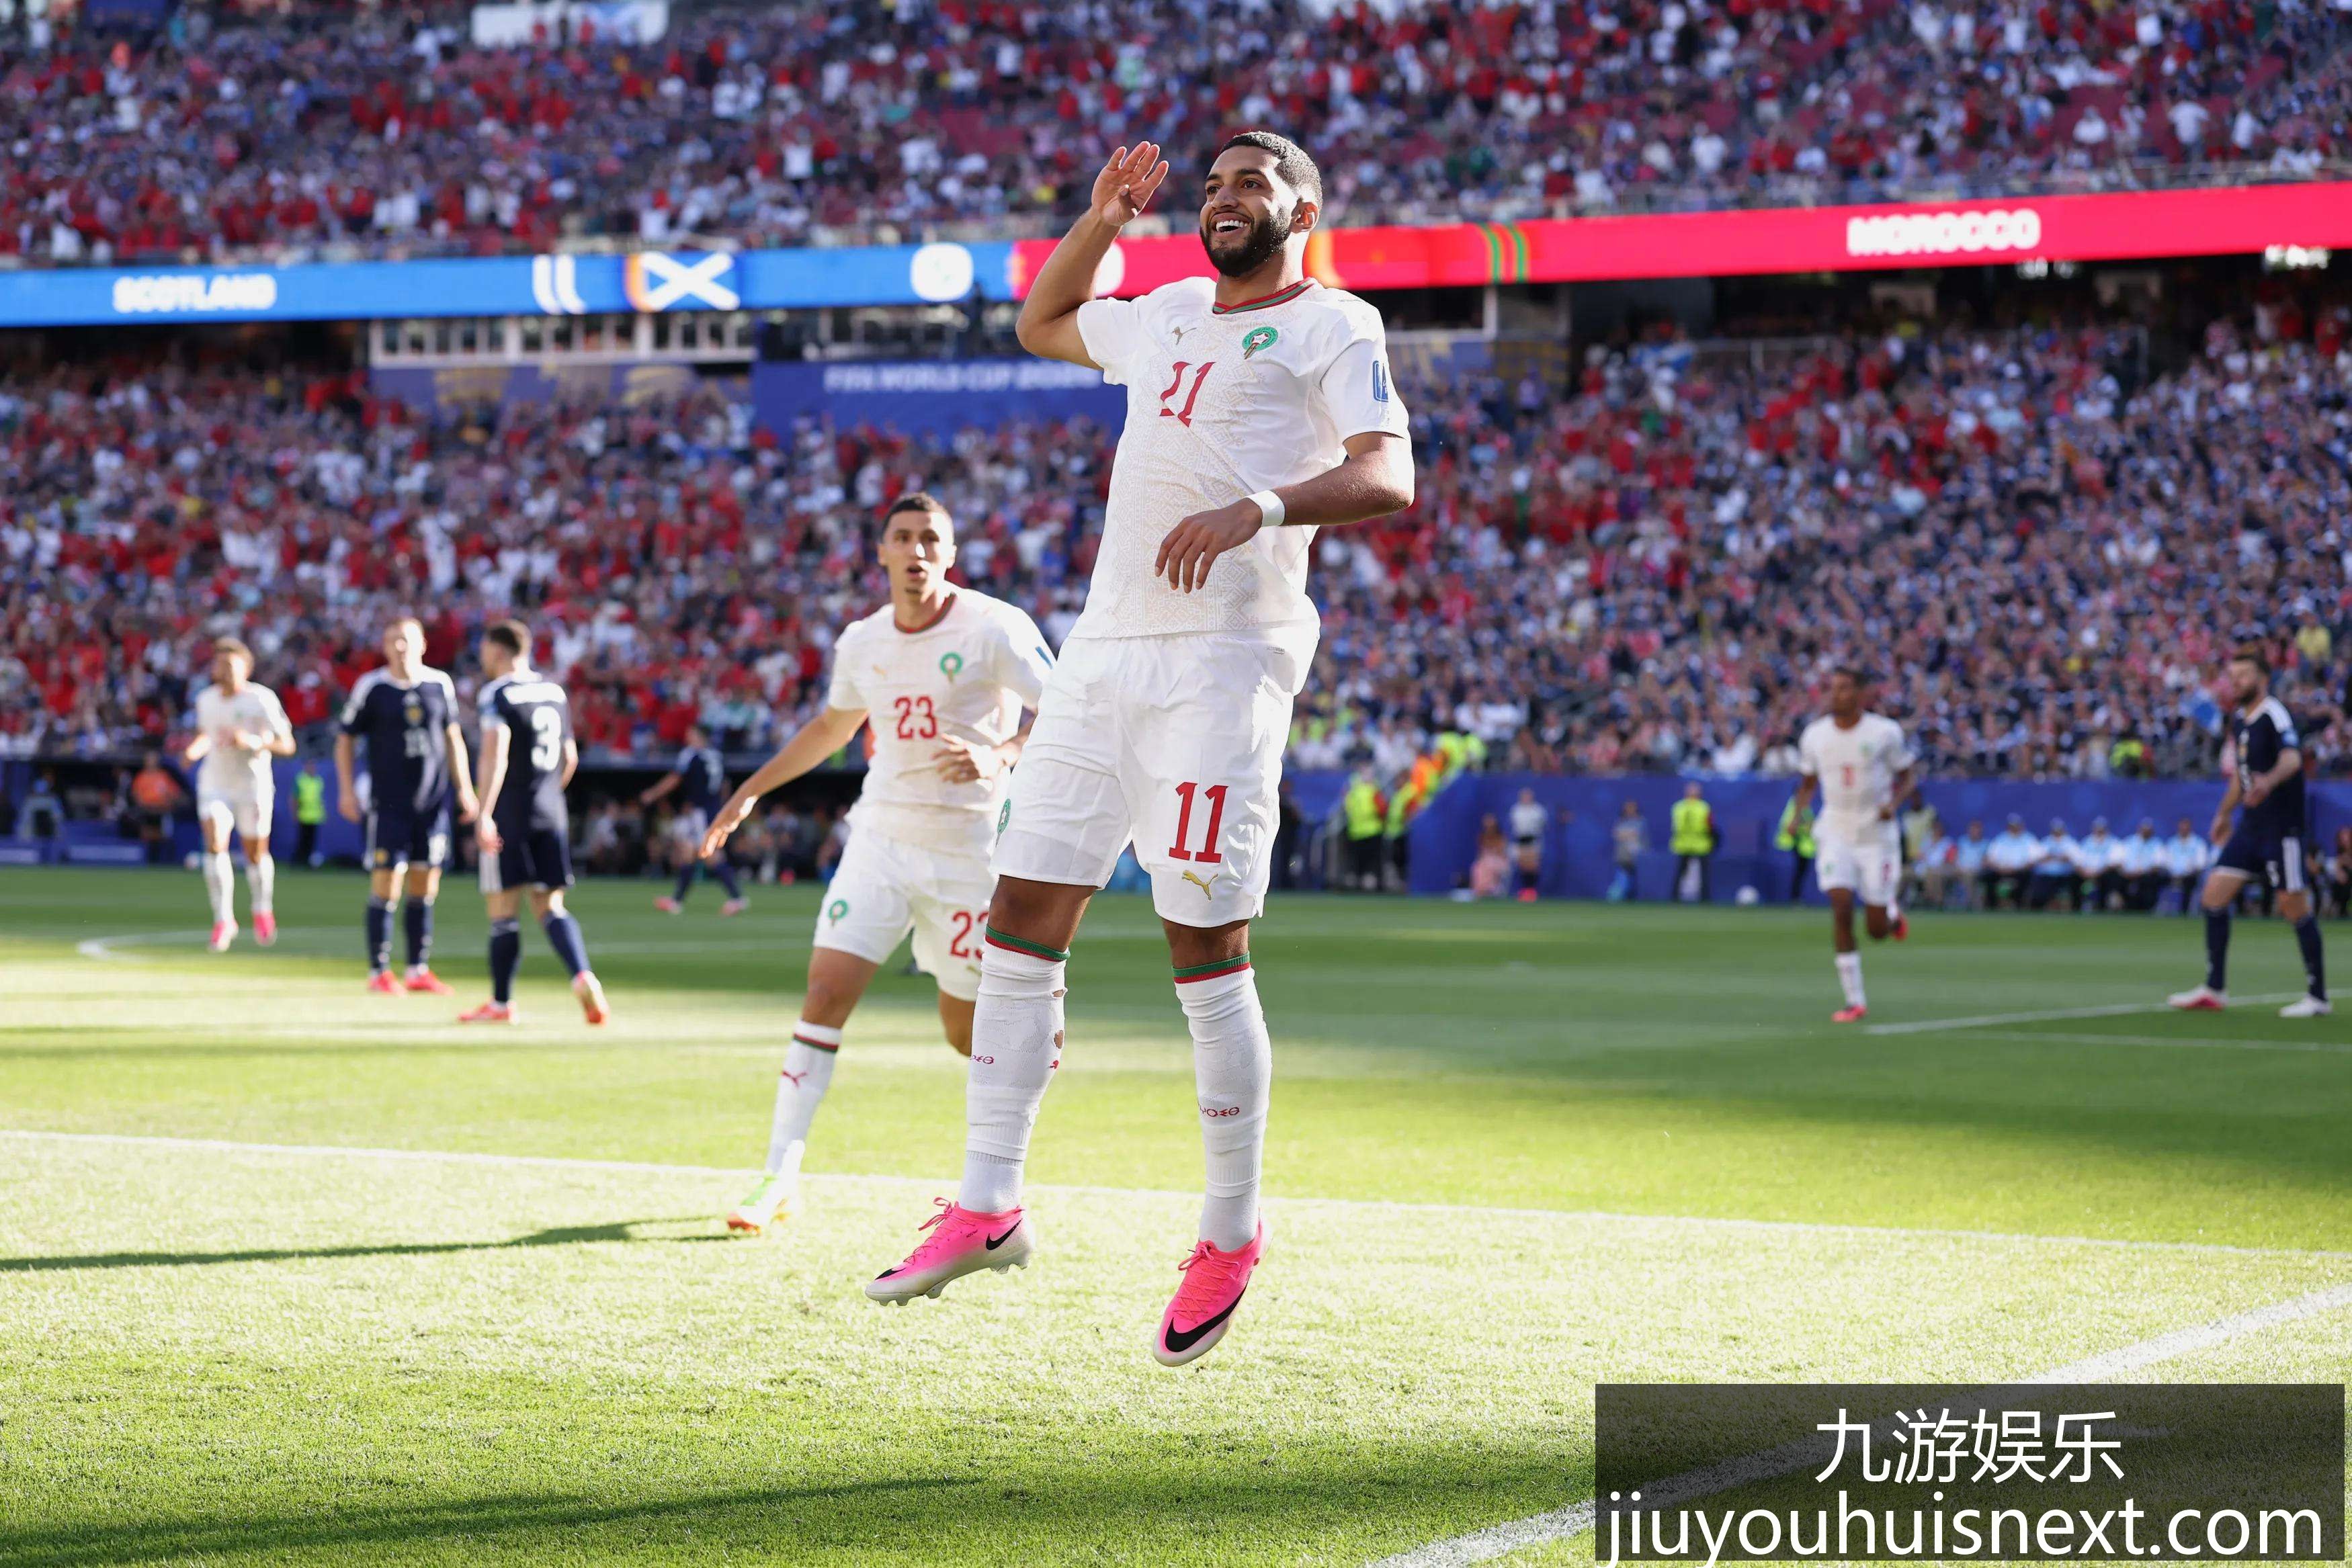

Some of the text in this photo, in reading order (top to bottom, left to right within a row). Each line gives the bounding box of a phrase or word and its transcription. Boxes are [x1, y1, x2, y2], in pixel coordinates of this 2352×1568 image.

[1847, 208, 2041, 257] MOROCCO
[113, 273, 278, 313] SCOTLAND
[530, 705, 561, 771] 3
[894, 695, 937, 740] 23
[1168, 781, 1229, 863] 11
